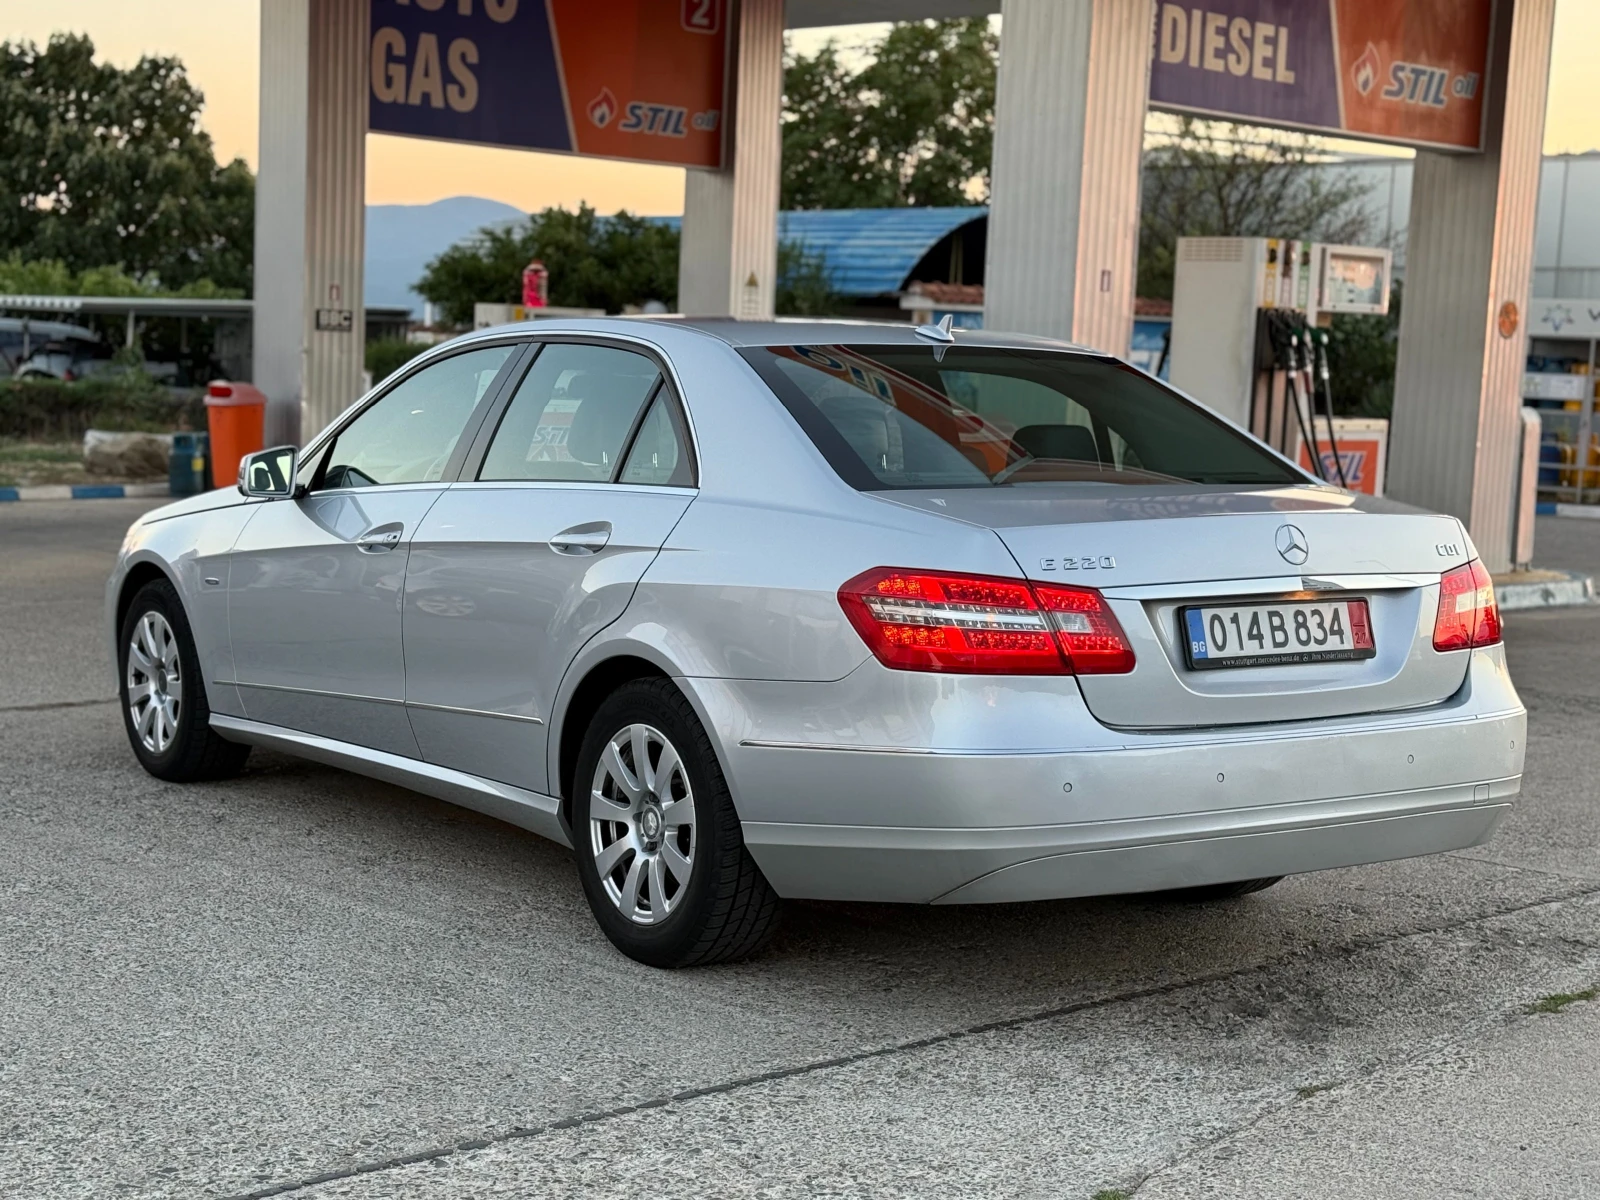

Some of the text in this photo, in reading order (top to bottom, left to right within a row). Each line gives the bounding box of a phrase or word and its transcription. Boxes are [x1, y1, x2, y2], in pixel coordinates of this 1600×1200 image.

[1160, 3, 1295, 84] DIESEL
[371, 26, 479, 113] GAS
[1383, 62, 1478, 107] STIL oil
[620, 102, 686, 136] STIL
[1040, 556, 1116, 571] E 220
[1435, 544, 1460, 556] CDI
[1192, 641, 1206, 653] BG
